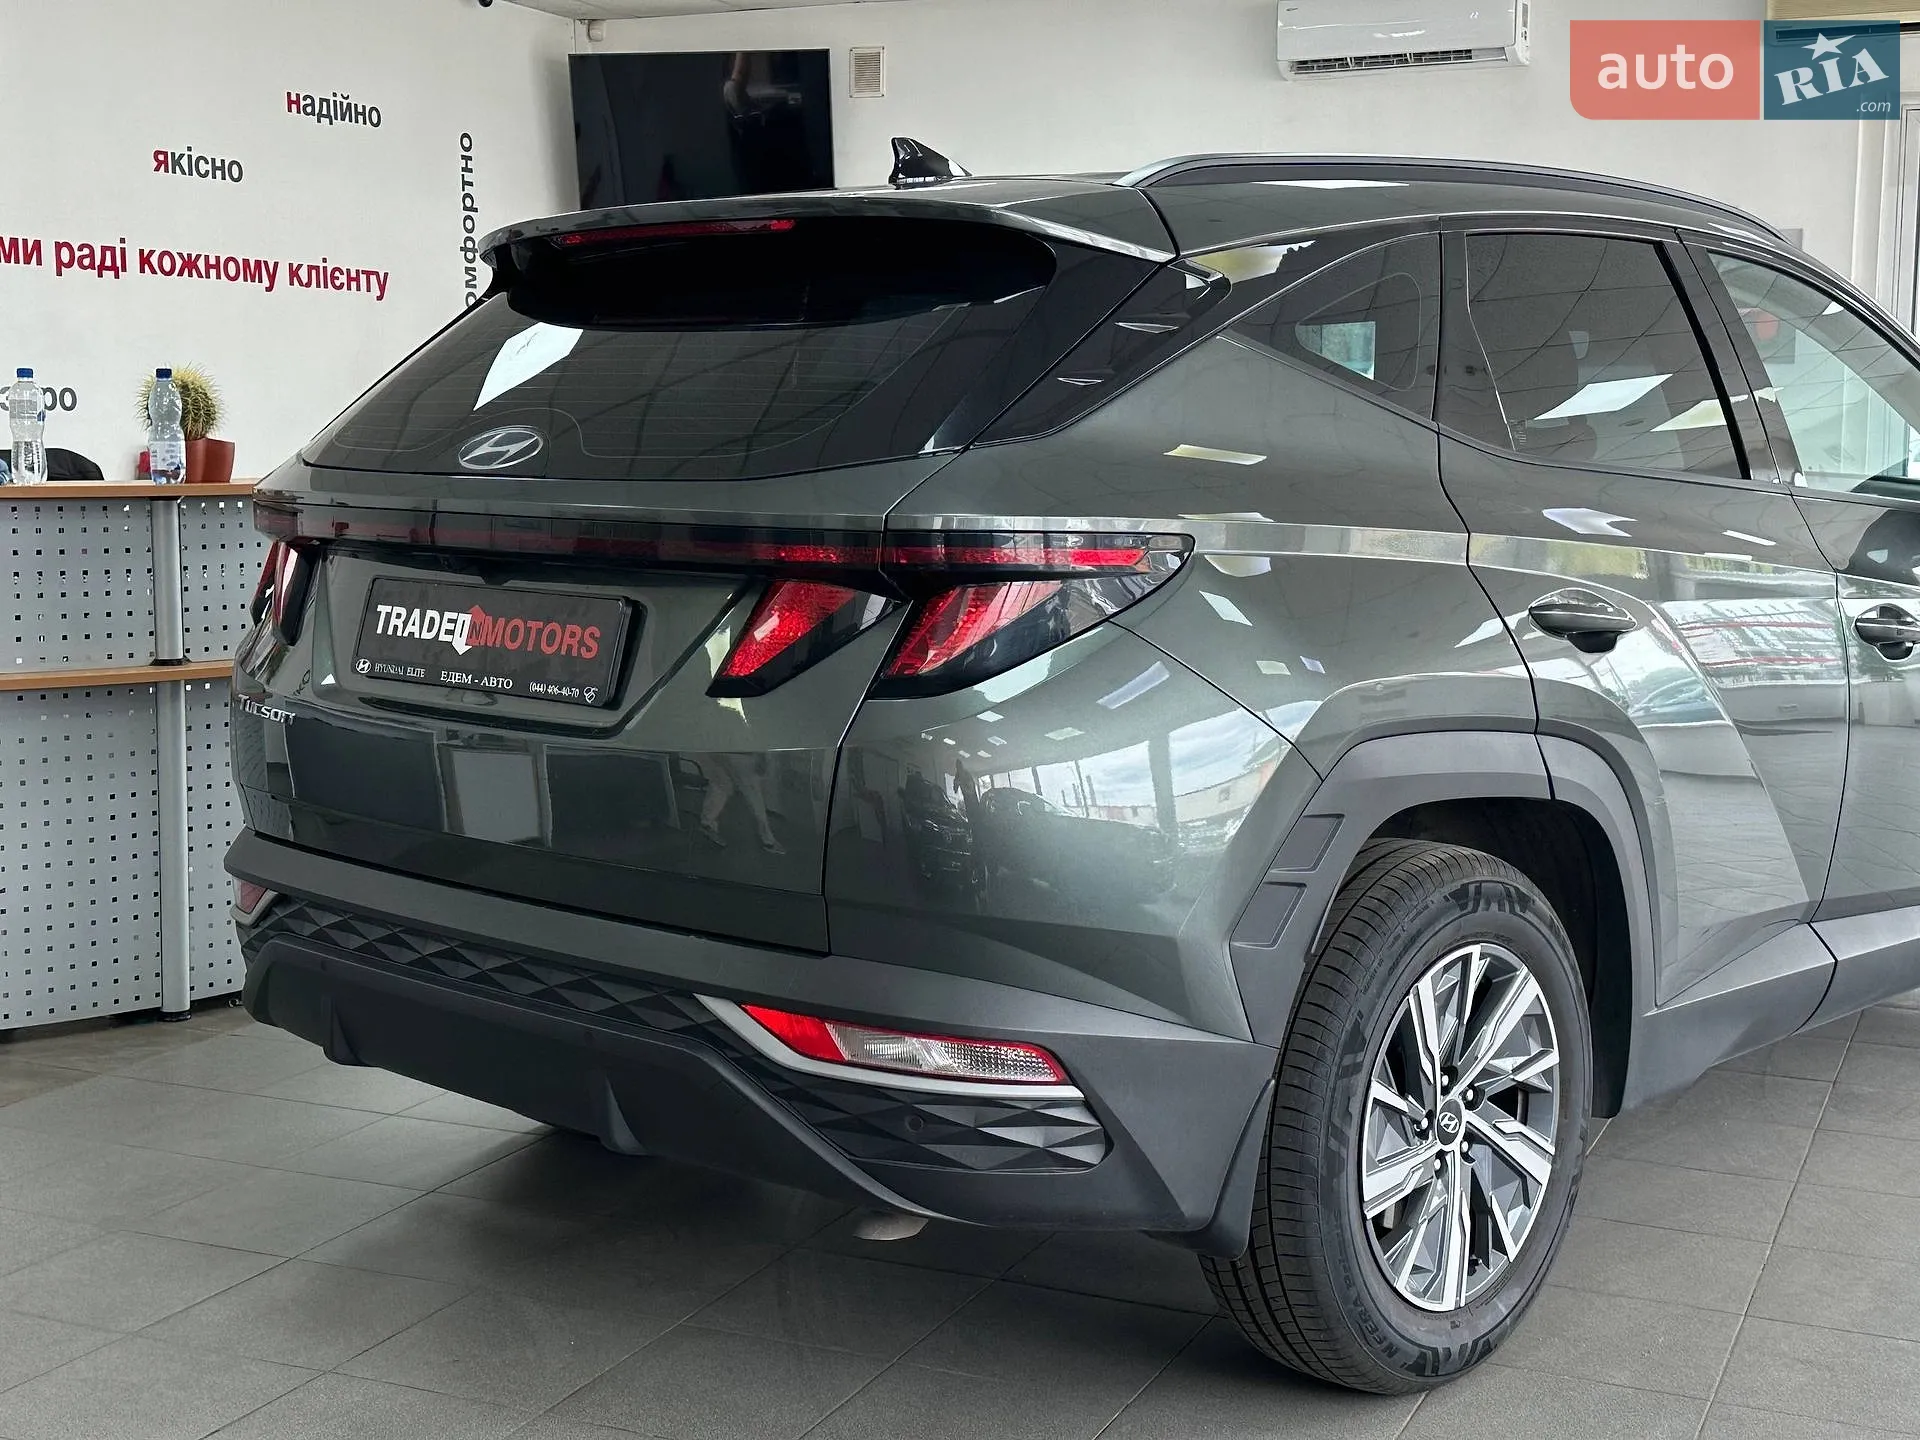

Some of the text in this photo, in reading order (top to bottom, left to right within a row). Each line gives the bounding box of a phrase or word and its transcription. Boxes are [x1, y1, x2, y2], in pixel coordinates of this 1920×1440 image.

[286, 91, 382, 128] надійно
[153, 146, 244, 183] якісно
[460, 132, 479, 308] омфортно
[54, 237, 127, 279] раді
[138, 247, 279, 293] кожному
[288, 257, 389, 302] клієнту
[375, 662, 426, 680] HYUNDAI ELITE
[441, 670, 472, 684] ЕДЕМ
[481, 676, 513, 690] АВТО
[529, 681, 547, 694] (044)
